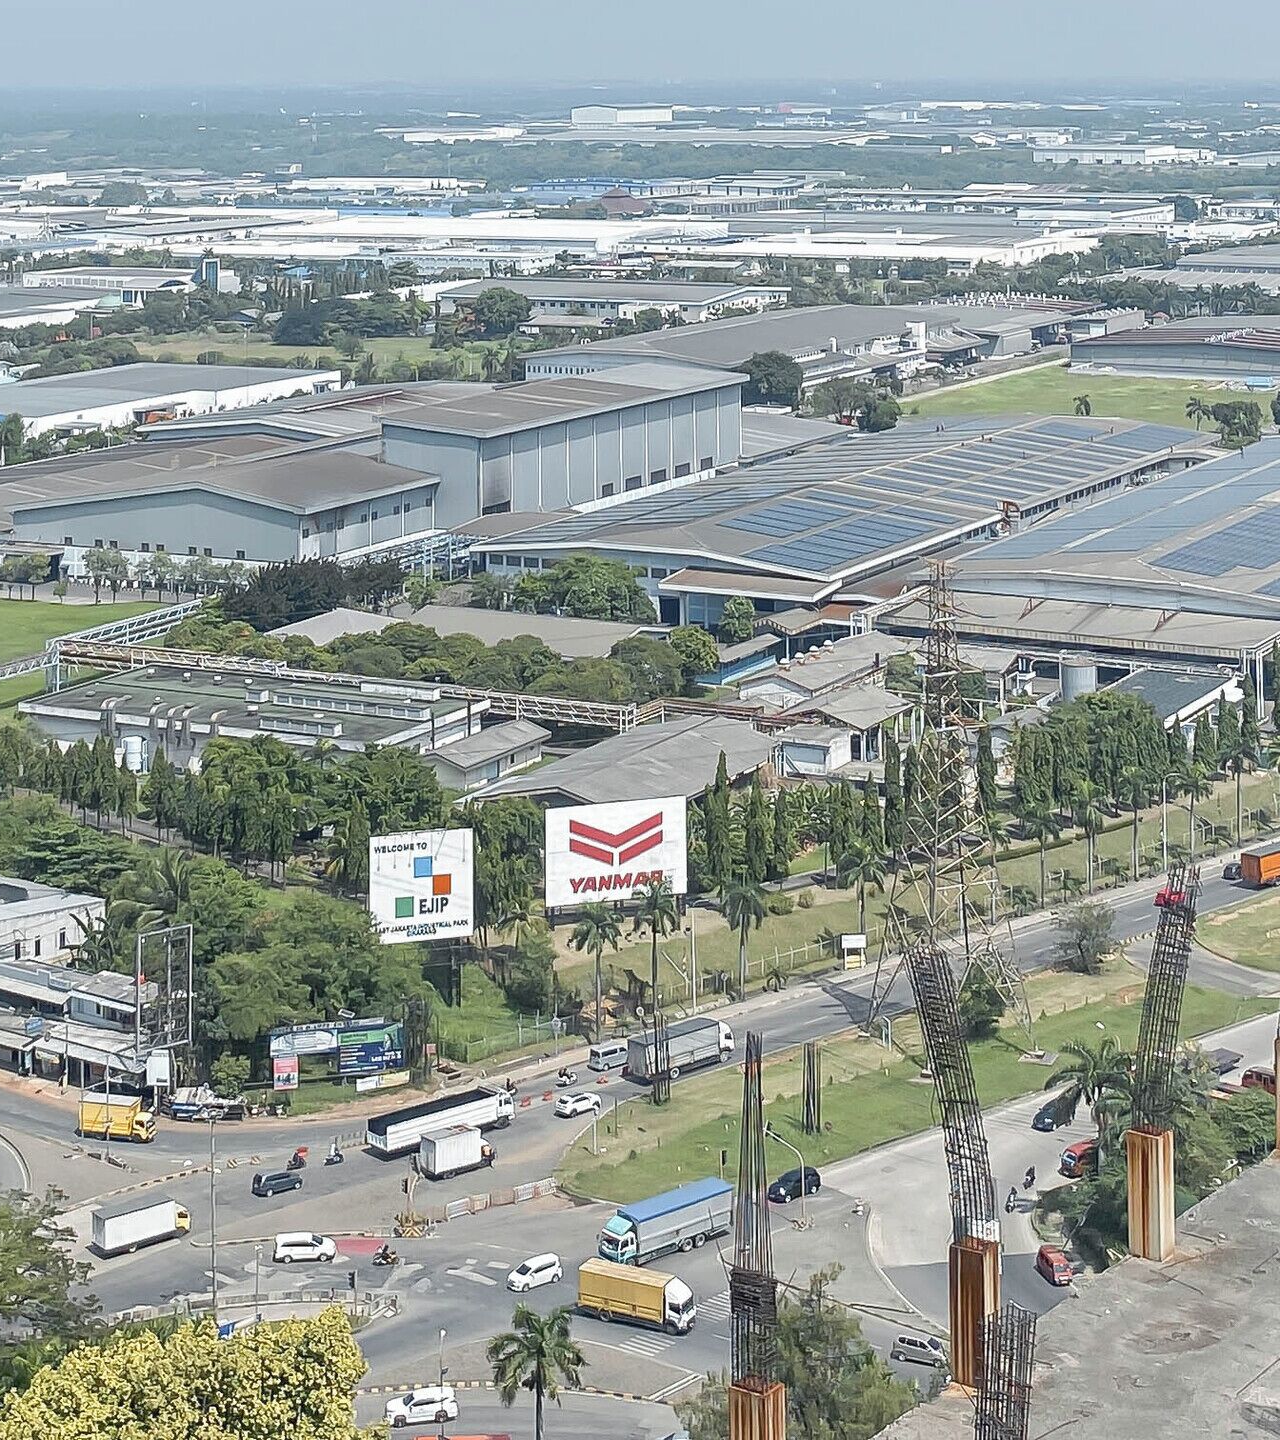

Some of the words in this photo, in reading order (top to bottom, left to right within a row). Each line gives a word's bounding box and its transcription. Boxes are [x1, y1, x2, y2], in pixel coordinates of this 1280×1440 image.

[374, 843, 415, 854] WELCOME
[416, 841, 428, 850] TO
[569, 870, 663, 893] YANMAR
[419, 897, 449, 914] EJIP
[418, 921, 452, 929] TRIAL
[453, 918, 469, 927] PARK
